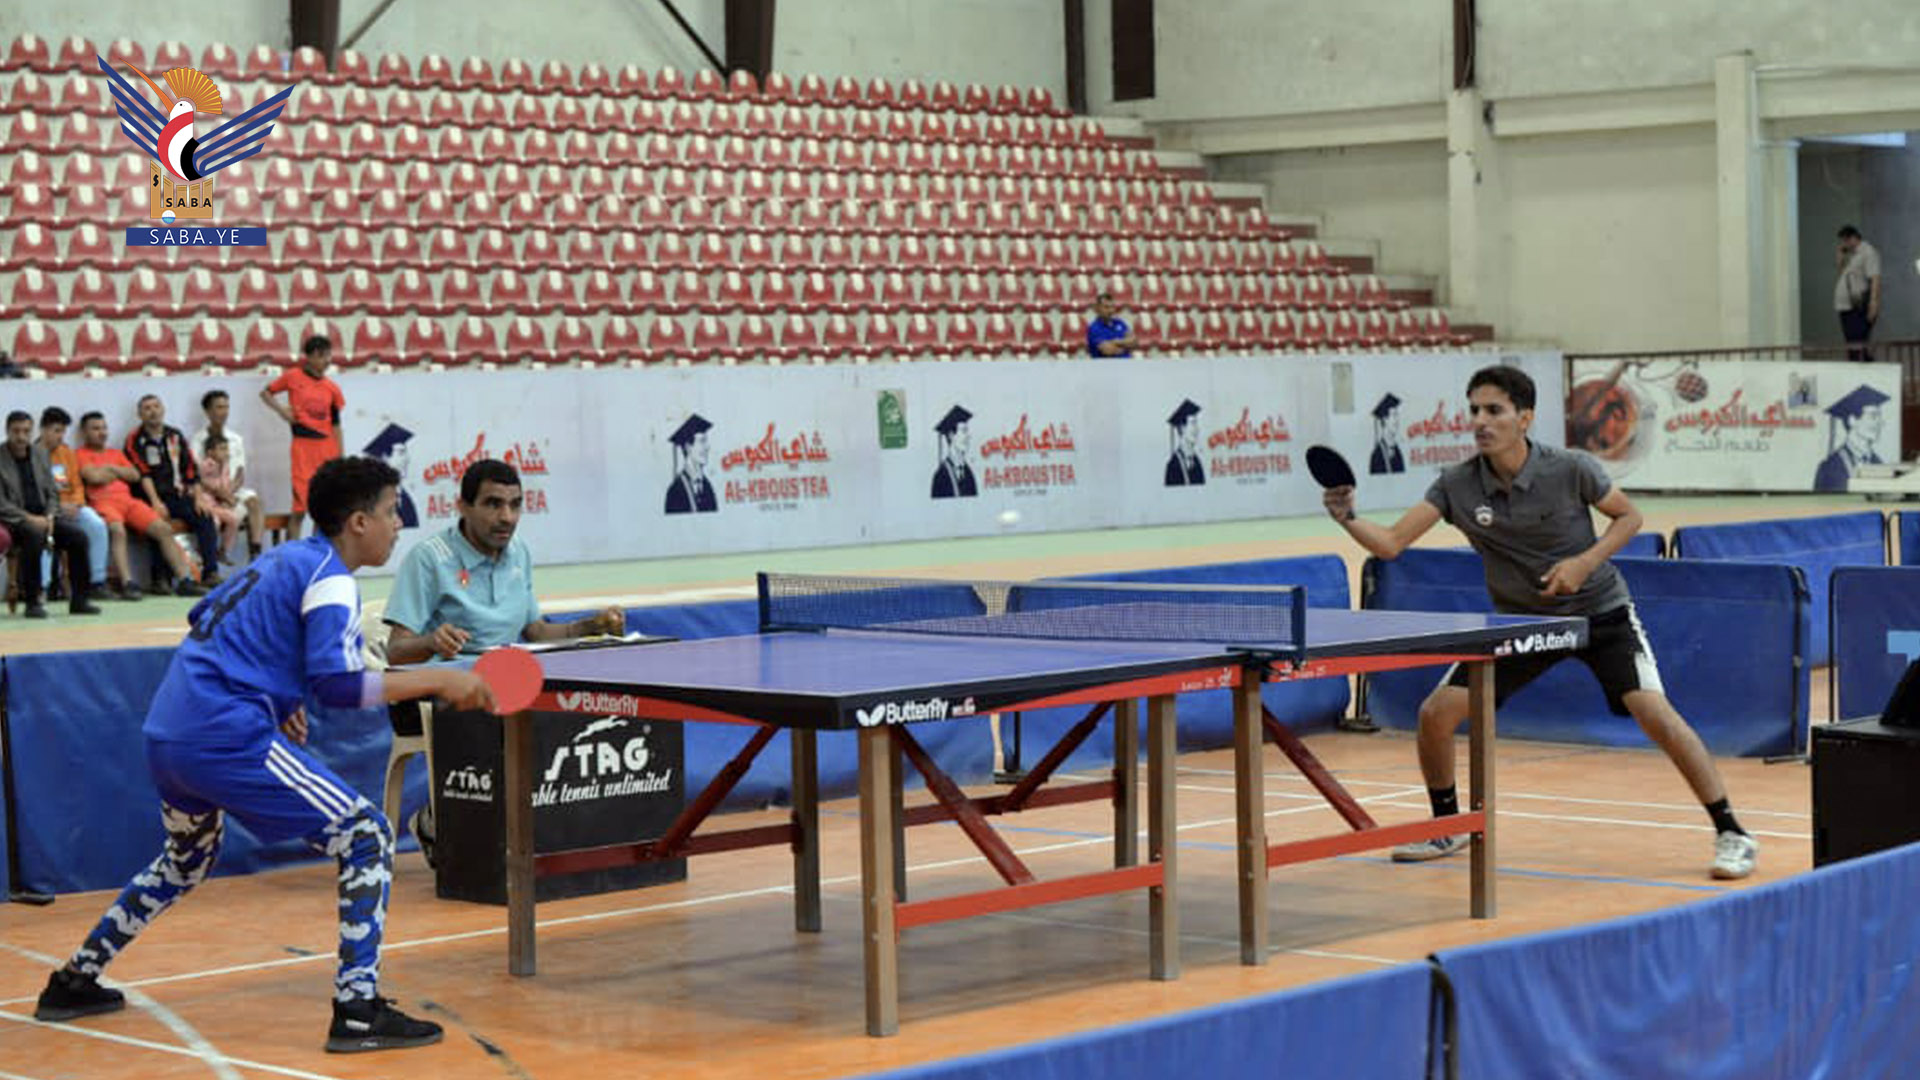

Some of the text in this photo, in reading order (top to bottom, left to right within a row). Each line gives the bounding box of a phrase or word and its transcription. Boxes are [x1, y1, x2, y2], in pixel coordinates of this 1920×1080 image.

[721, 421, 829, 471] شاي الكبوس
[981, 412, 1075, 459] شاي الكبوس
[725, 476, 830, 503] AL-KBOUS TEA
[984, 464, 1076, 489] AL-KBOUS TEA
[582, 691, 639, 716] Butterfly
[886, 697, 948, 723] Butterfly
[545, 737, 649, 780] STAG
[445, 770, 492, 791] STAG
[560, 779, 600, 803] tennis
[604, 769, 671, 797] unlimited
